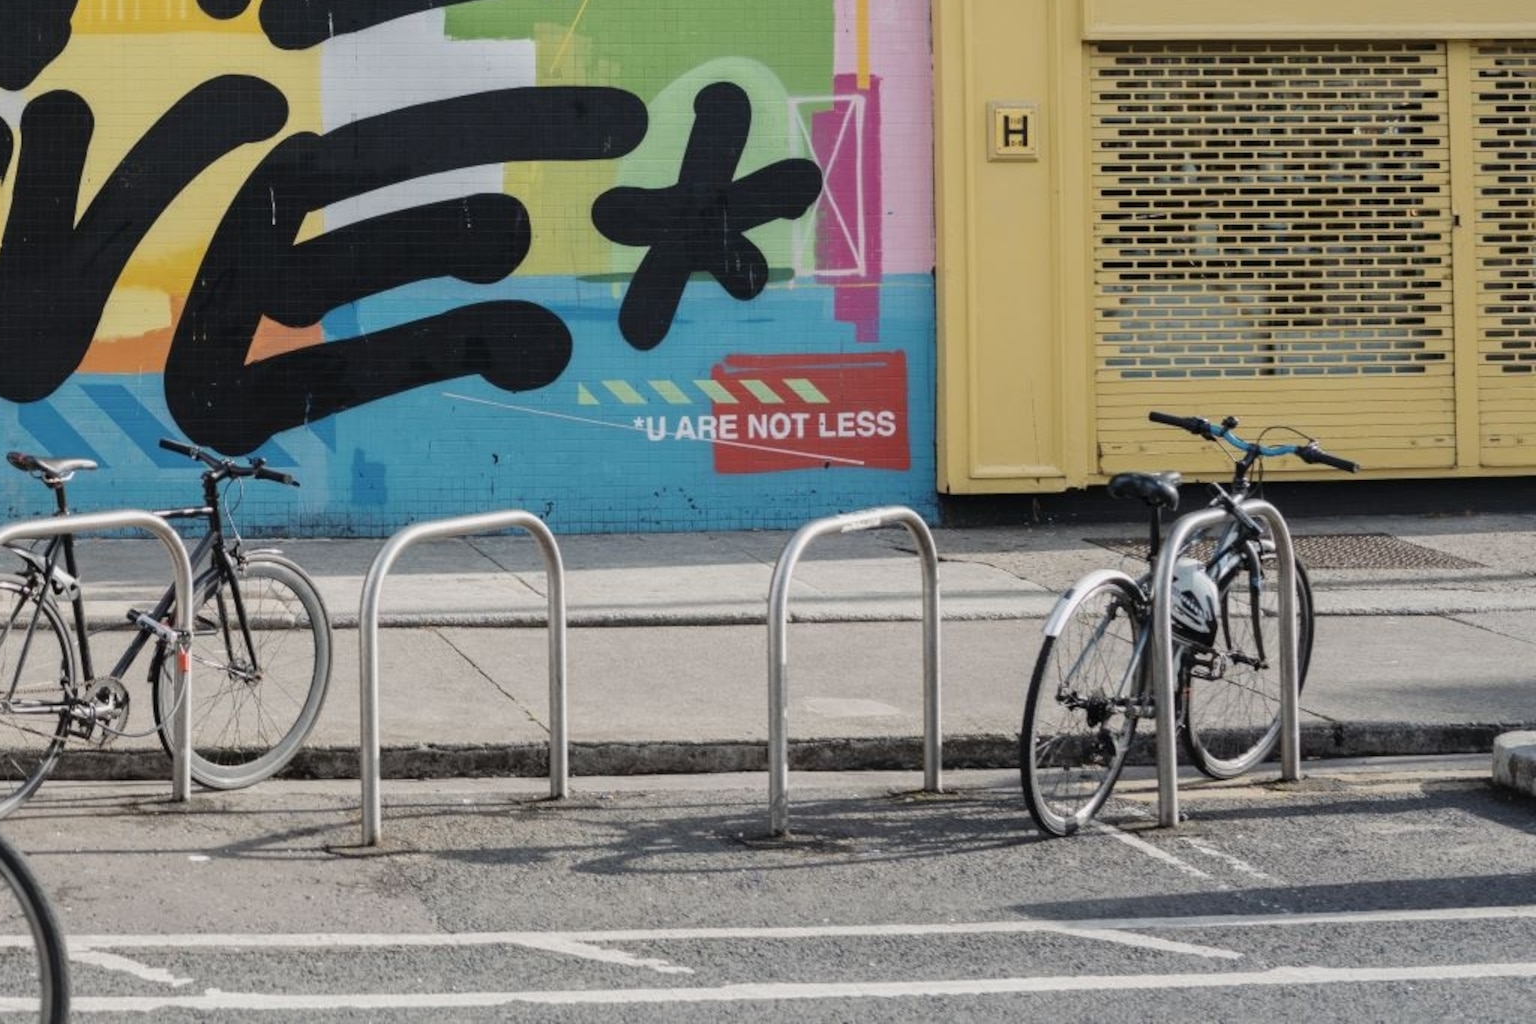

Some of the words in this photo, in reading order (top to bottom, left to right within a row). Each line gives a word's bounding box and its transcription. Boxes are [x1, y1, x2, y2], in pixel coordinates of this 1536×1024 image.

[1004, 115, 1028, 147] H
[674, 414, 738, 440] ARE
[748, 412, 810, 439] NOT
[819, 411, 896, 438] LESS
